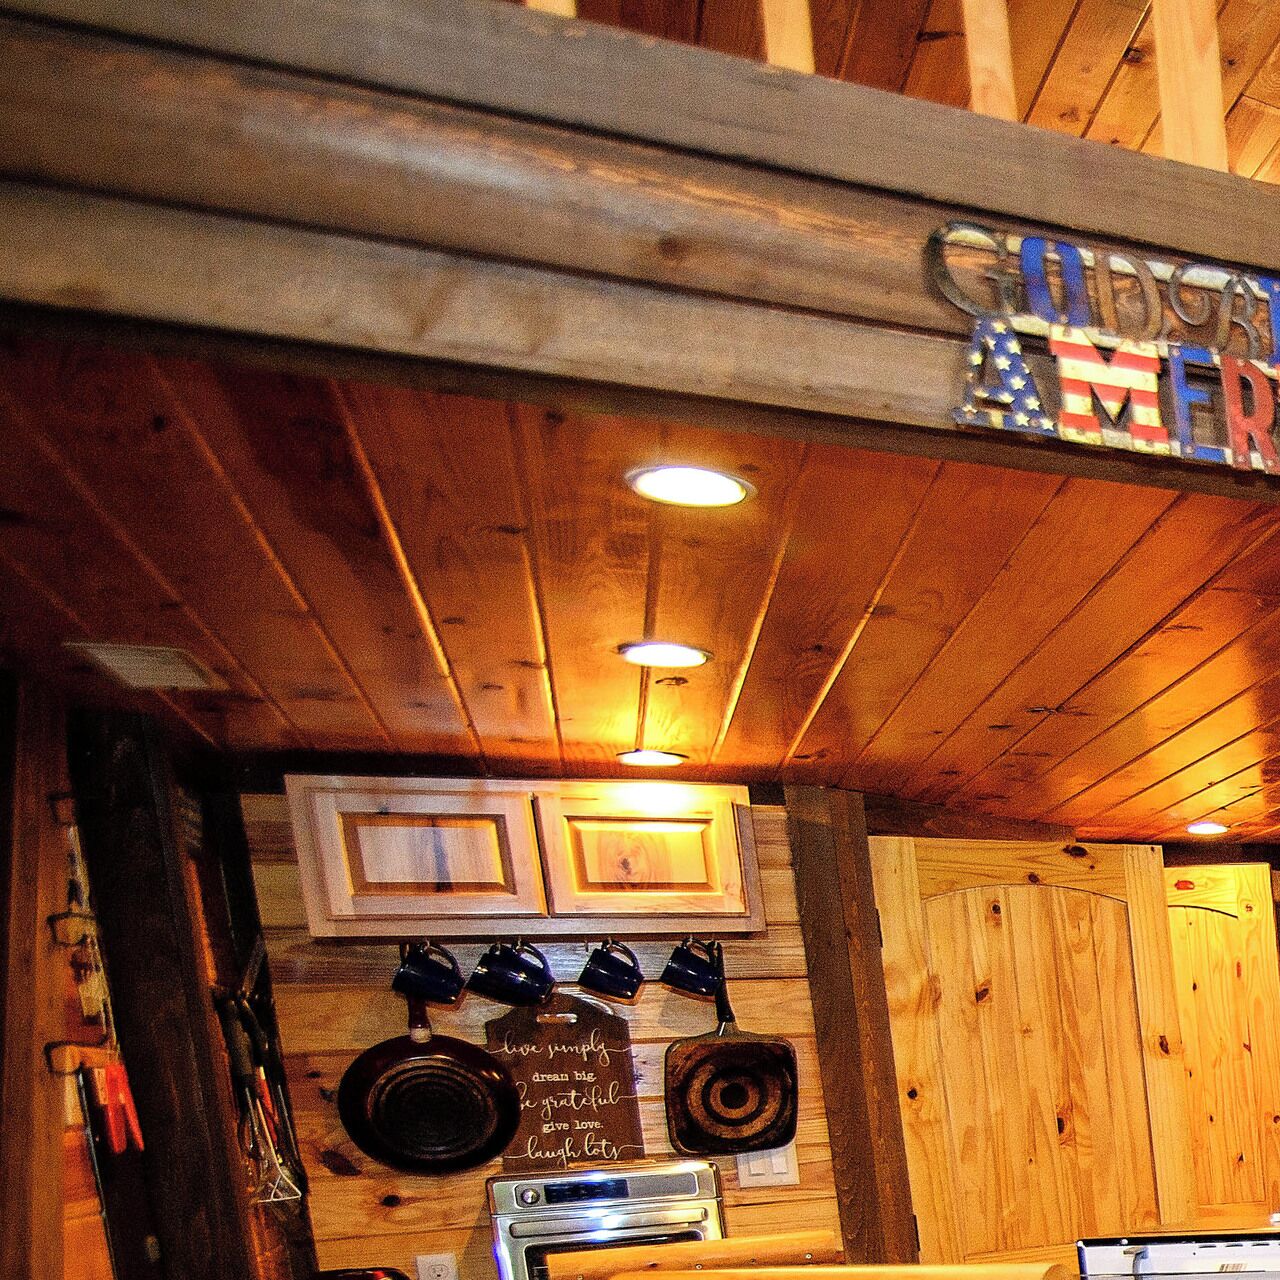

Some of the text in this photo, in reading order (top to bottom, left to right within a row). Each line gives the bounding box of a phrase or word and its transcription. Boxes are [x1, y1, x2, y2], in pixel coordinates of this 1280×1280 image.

[498, 1028, 624, 1067] live simply
[532, 1072, 569, 1082] dream
[541, 1081, 624, 1121] grateful
[542, 1121, 570, 1134] give
[518, 1132, 626, 1170] laugh lots
